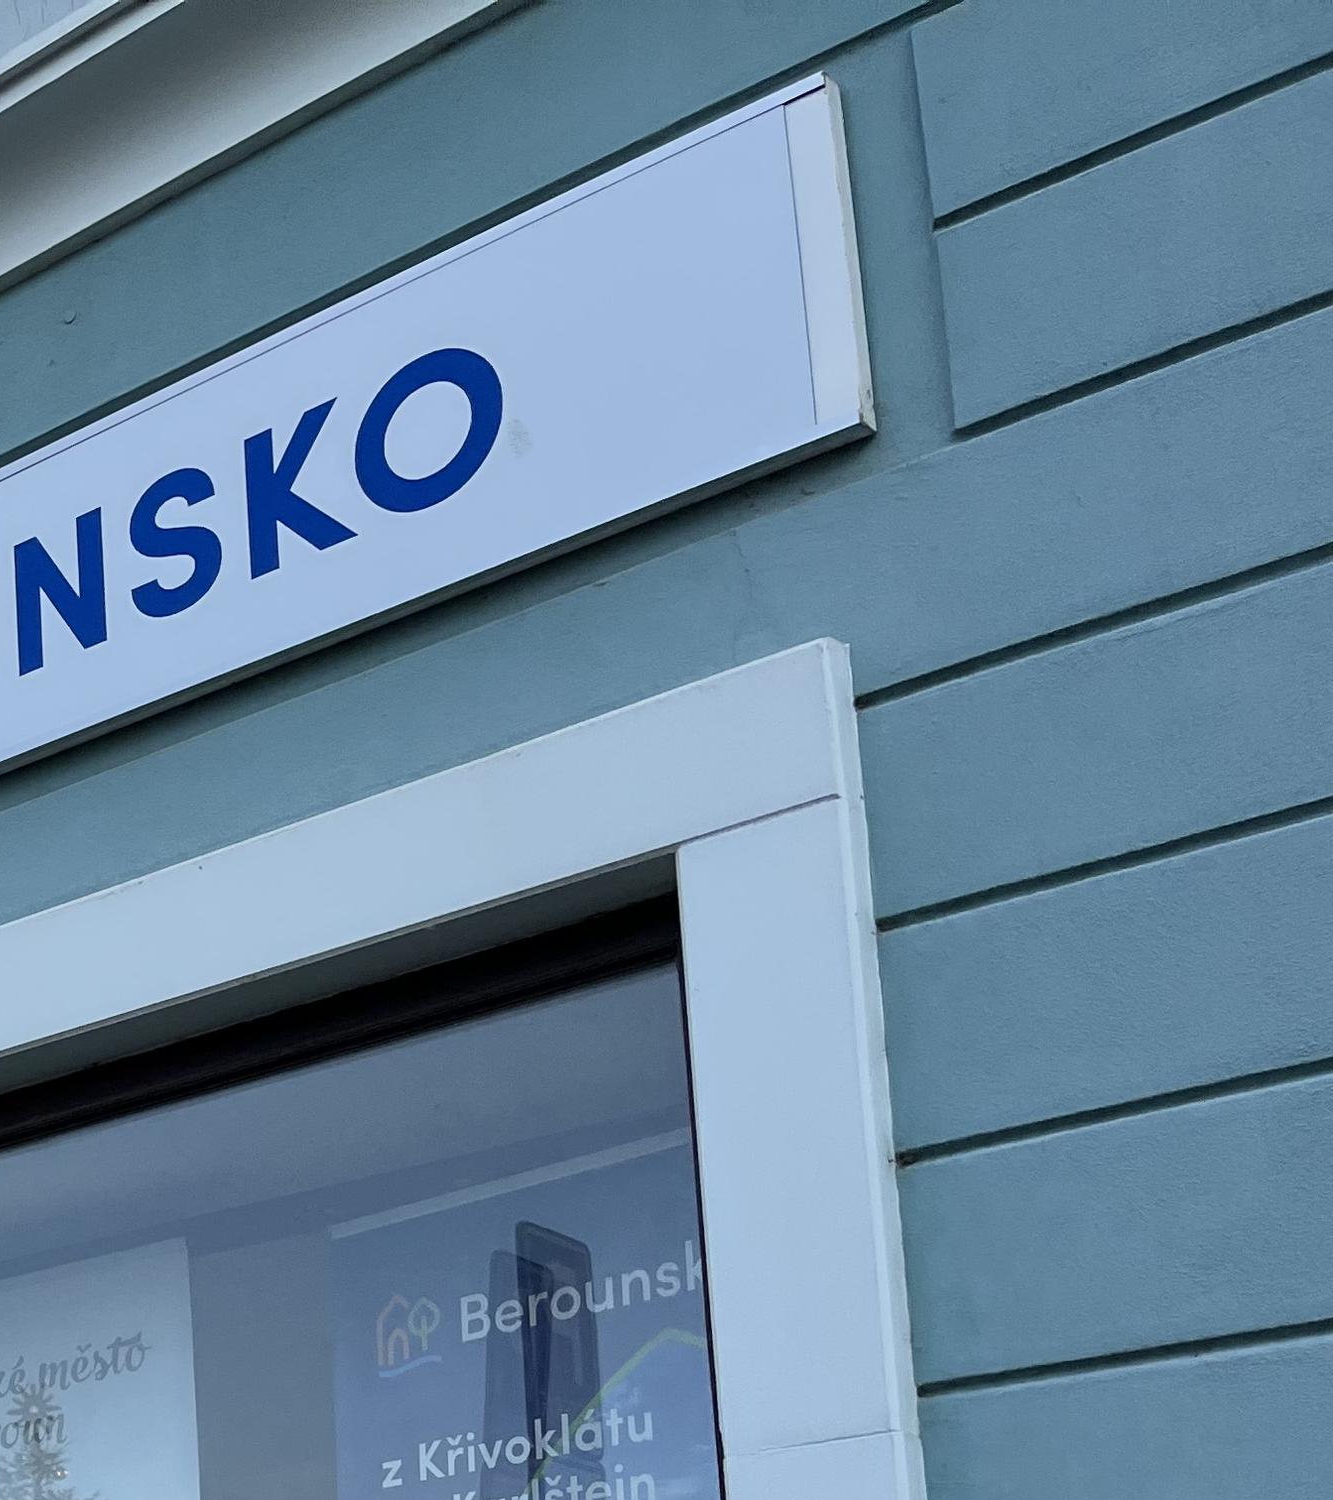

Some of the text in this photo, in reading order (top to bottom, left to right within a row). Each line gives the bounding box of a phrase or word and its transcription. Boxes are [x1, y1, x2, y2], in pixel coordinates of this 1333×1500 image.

[38, 1331, 152, 1391] město
[381, 1407, 654, 1489] z Křivoklátu
